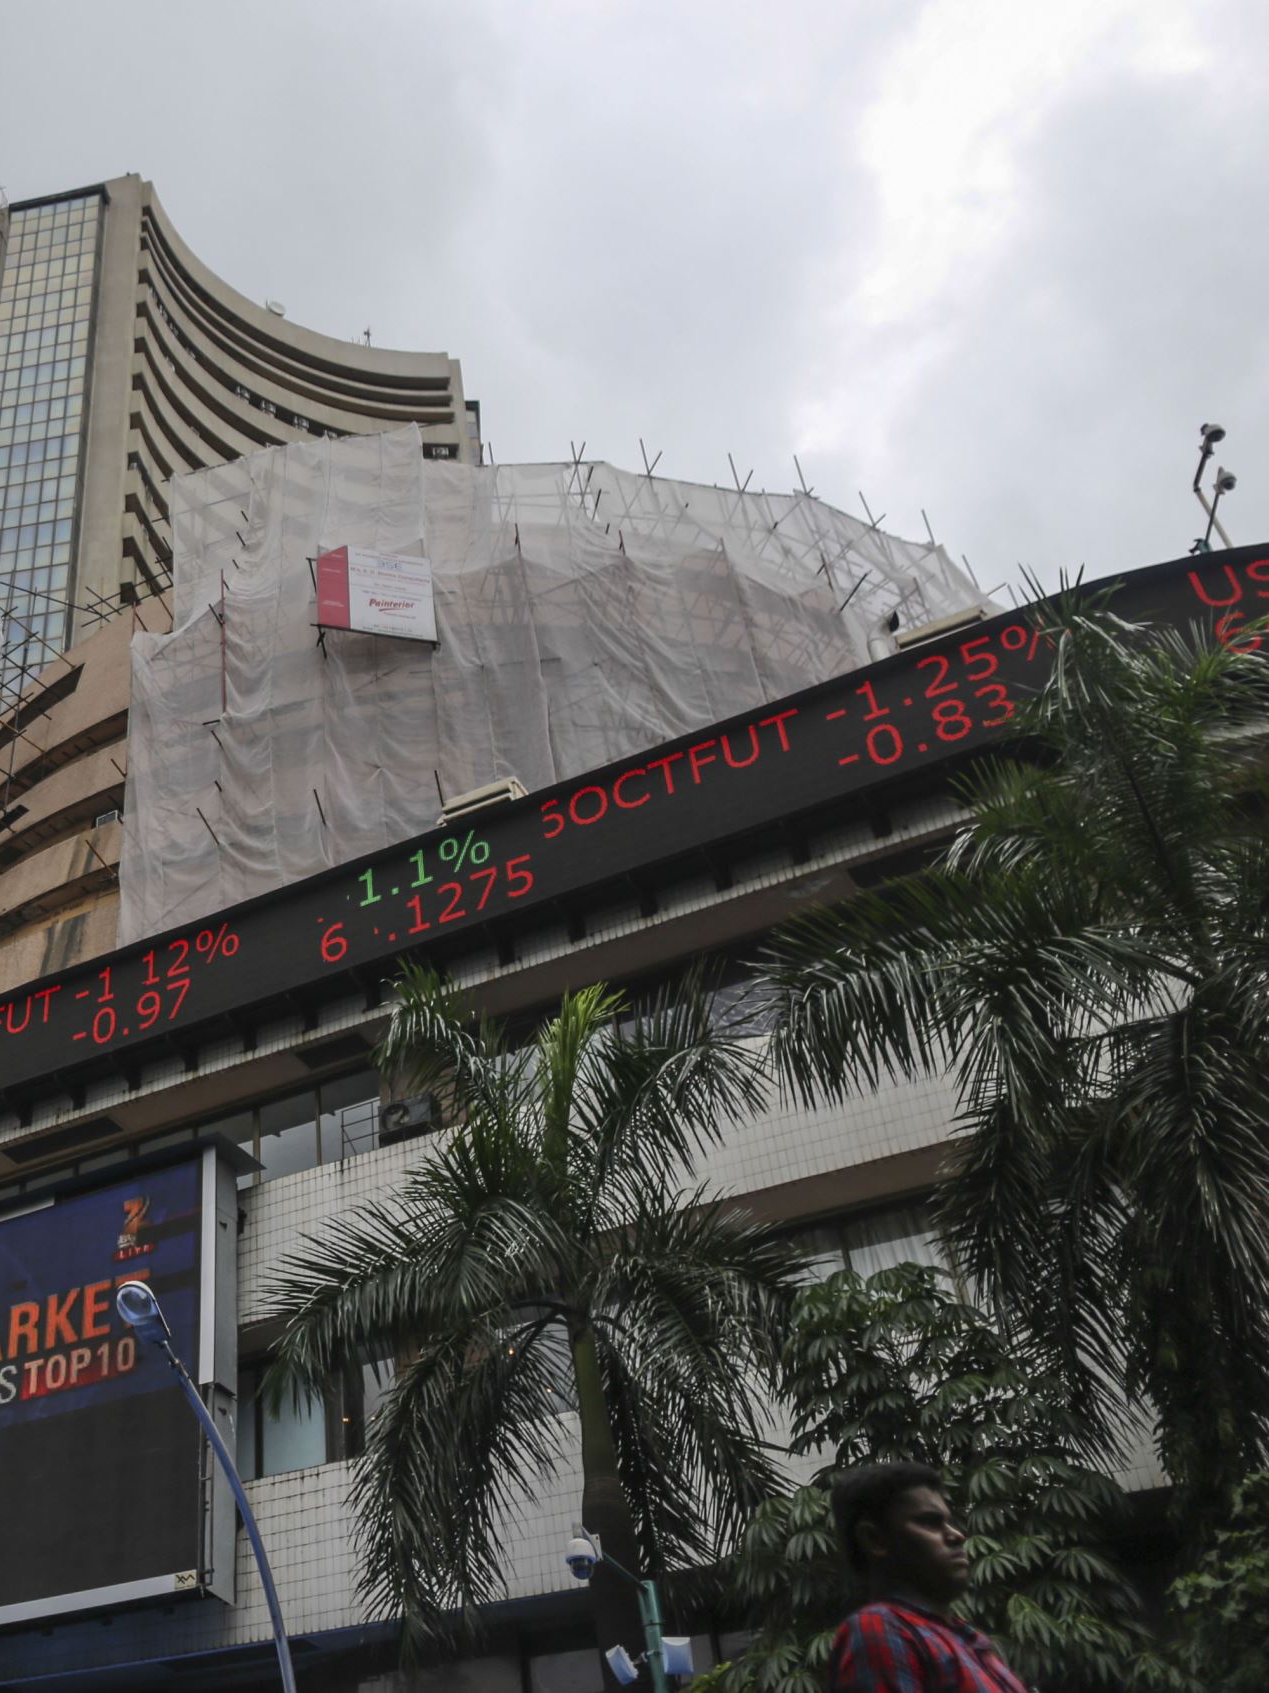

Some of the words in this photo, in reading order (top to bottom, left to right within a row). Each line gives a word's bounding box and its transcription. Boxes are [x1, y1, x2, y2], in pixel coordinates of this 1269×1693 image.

[368, 597, 415, 608] Painterior
[838, 684, 1016, 766] -0.83
[73, 978, 191, 1044] -0.97
